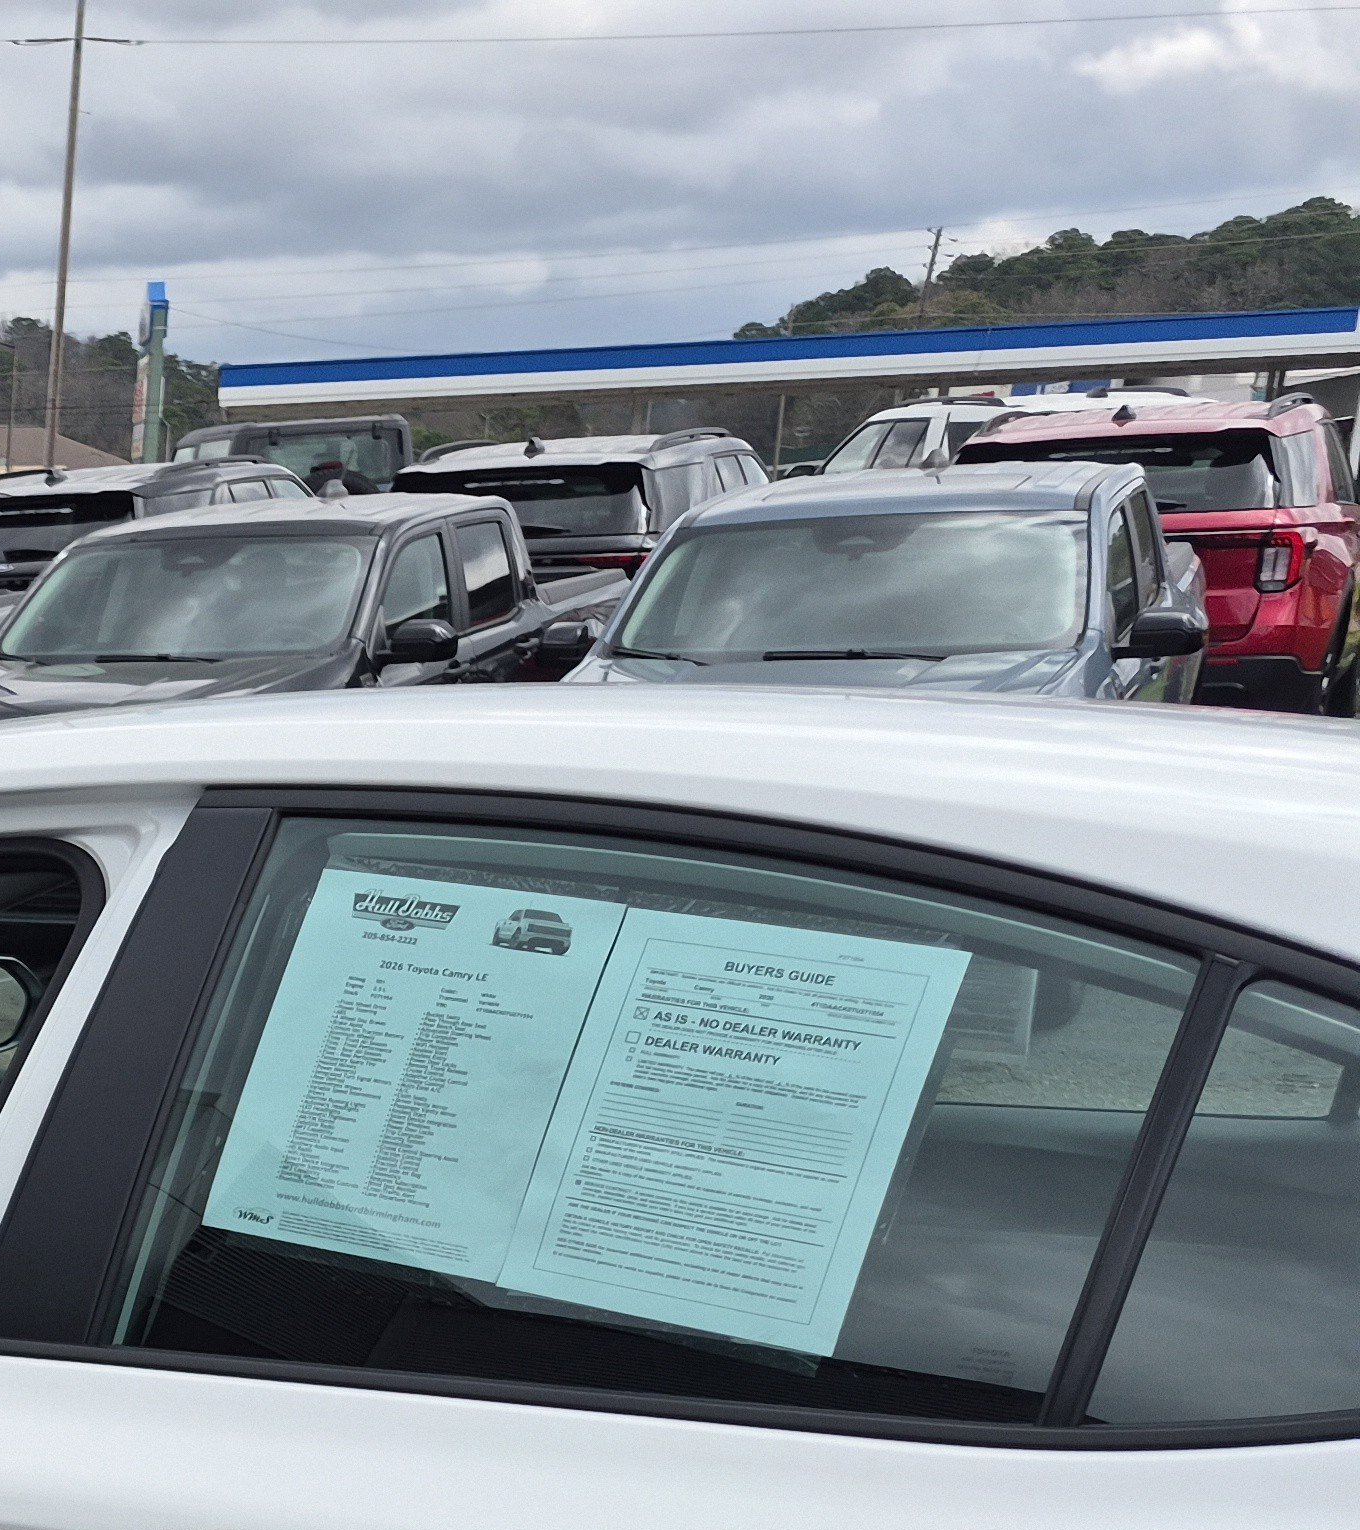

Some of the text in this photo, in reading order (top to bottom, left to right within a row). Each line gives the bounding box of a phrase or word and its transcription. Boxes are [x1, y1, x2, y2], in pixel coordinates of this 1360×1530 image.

[379, 959, 489, 983] 2026 Toyota Camry LE
[723, 960, 836, 986] BUYERS GUIDE
[652, 1010, 673, 1022] AS
[674, 1013, 689, 1024] IS
[698, 1017, 721, 1029] NO
[721, 1020, 778, 1038] DEALER
[779, 1029, 862, 1051] WARRANTY
[643, 1035, 700, 1053] DEALER
[700, 1044, 781, 1066] WARRANTY
